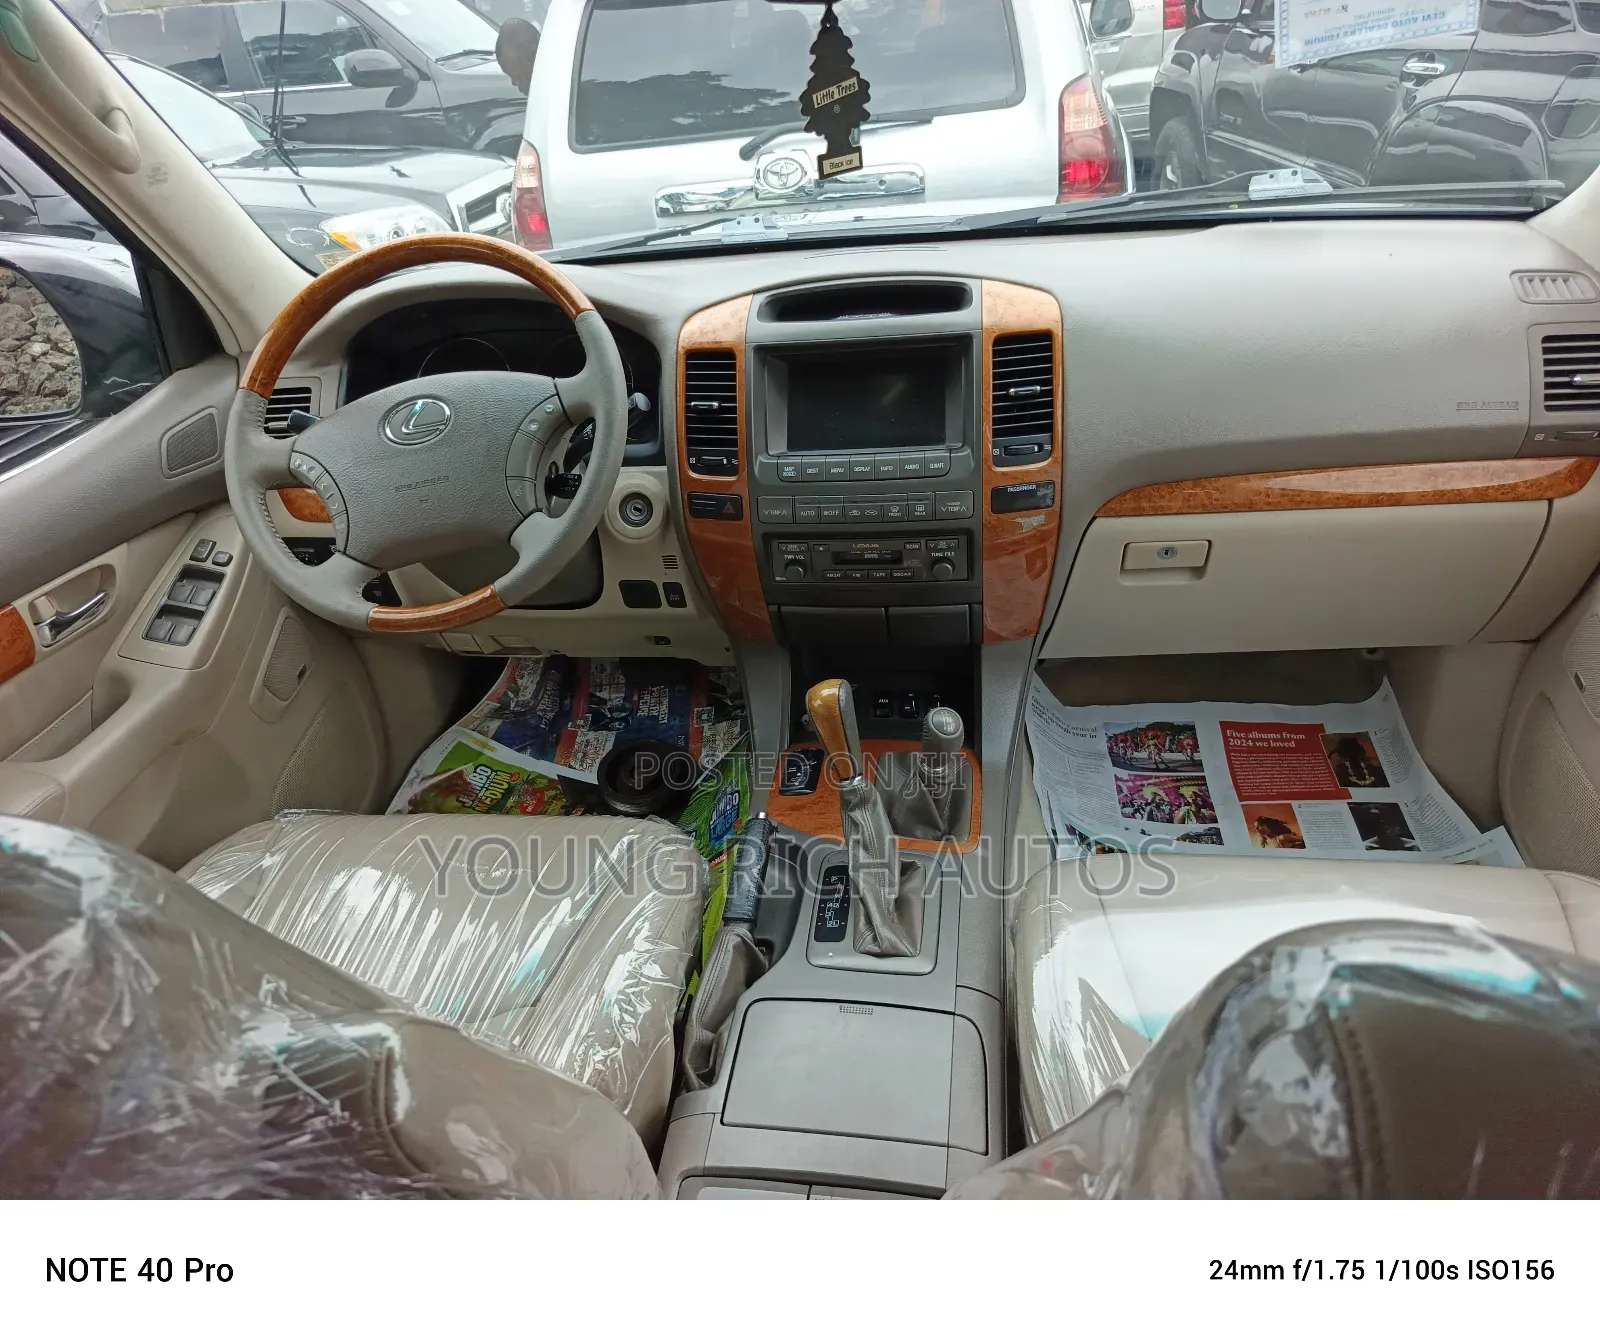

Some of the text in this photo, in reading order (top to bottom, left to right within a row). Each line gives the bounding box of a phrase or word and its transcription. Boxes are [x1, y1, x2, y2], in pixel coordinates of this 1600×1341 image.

[1391, 16, 1419, 28] AUTO
[816, 80, 857, 107] Little Trees
[829, 158, 854, 170] Black Ice
[1007, 484, 1037, 493] PASSENGER
[1226, 729, 1306, 740] Five albums from
[1228, 738, 1254, 746] 2024
[1270, 739, 1296, 748] loved
[475, 770, 511, 813] MEDIUM
